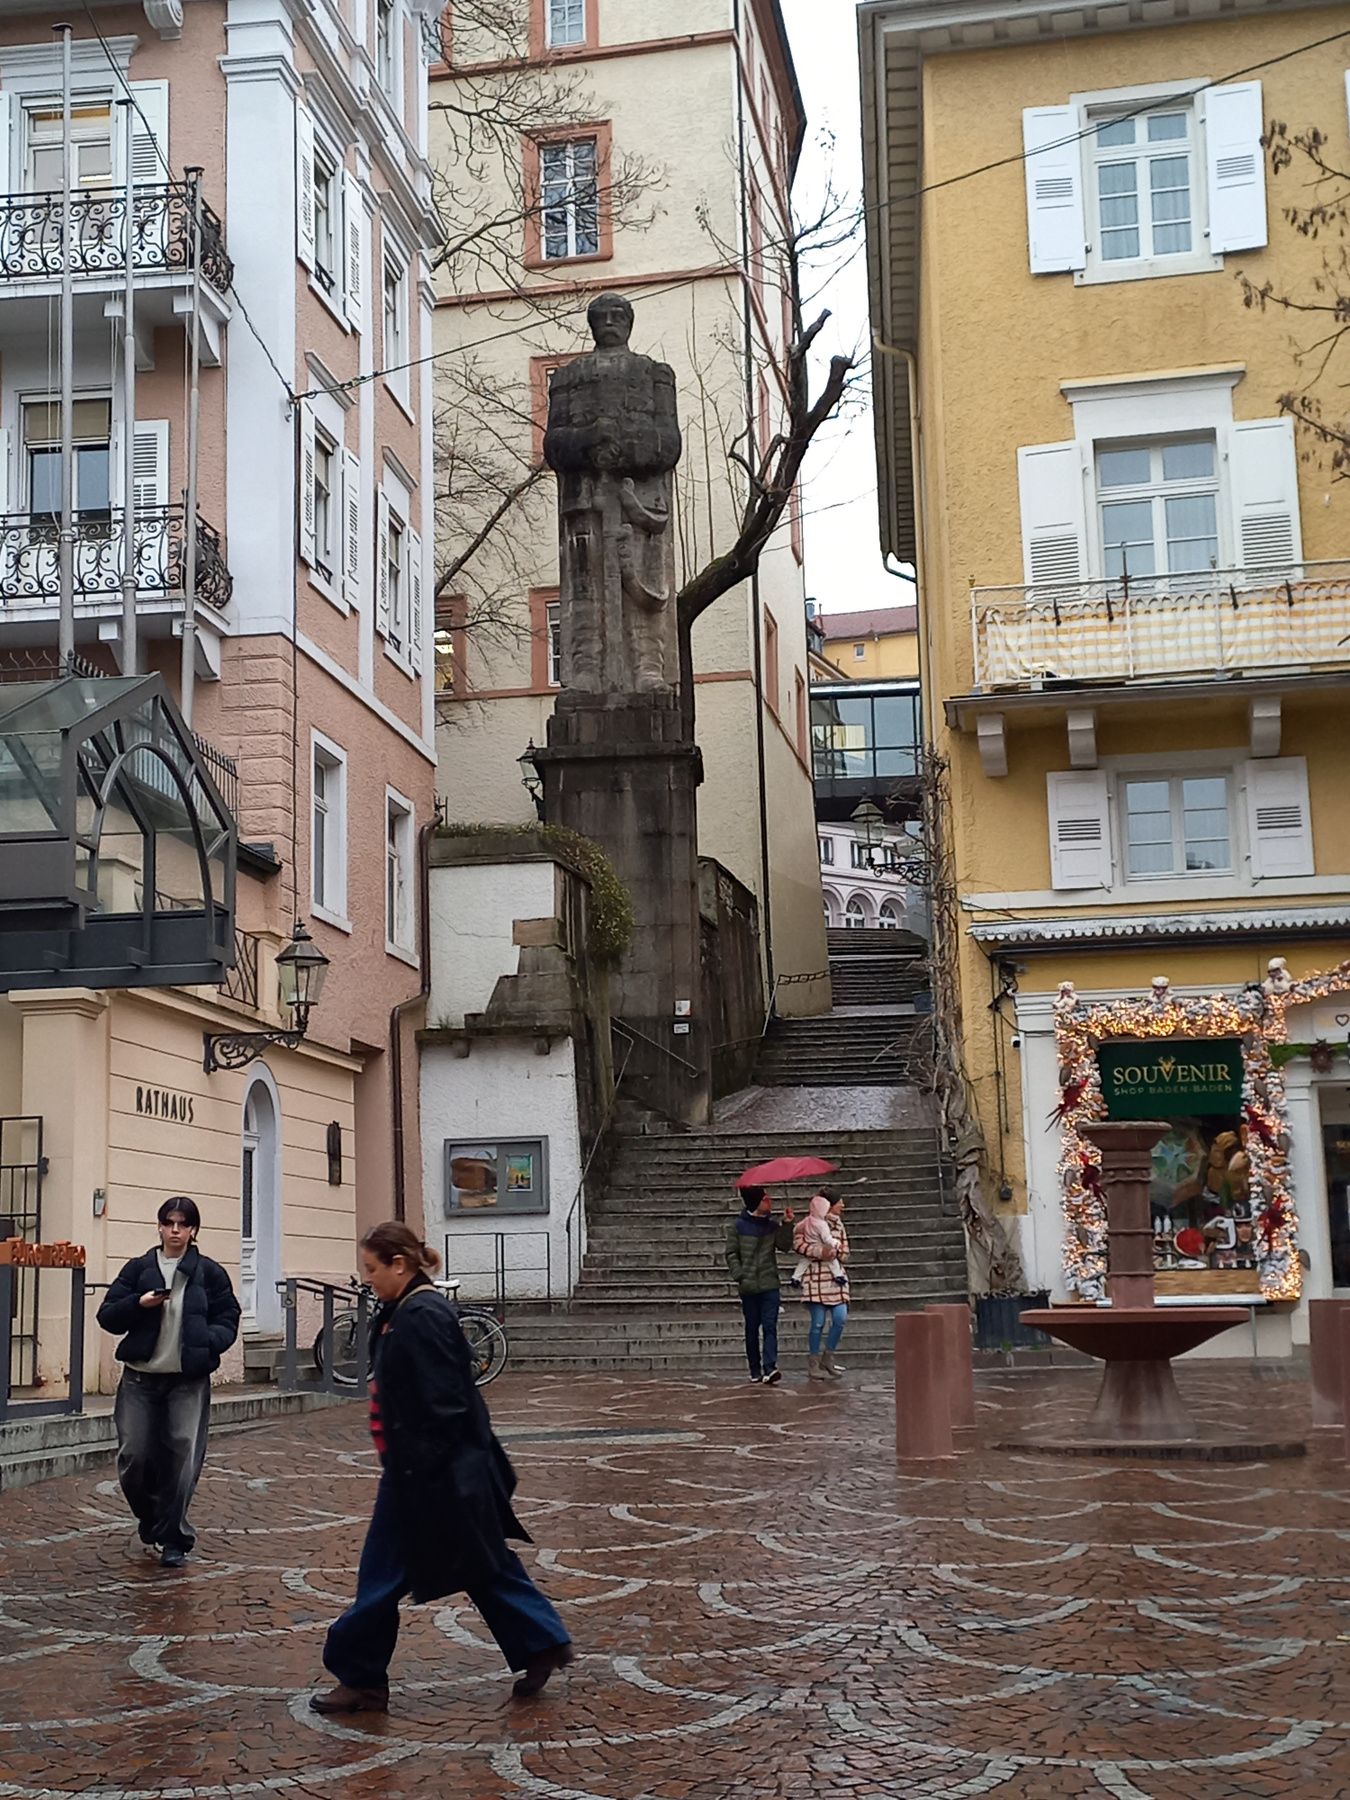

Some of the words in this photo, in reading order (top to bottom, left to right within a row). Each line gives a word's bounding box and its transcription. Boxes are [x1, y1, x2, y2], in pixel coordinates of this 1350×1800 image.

[1113, 1063, 1231, 1085] SOUVENIR
[1114, 1087, 1145, 1096] SHOP
[1149, 1084, 1233, 1094] BADEN-BADEN
[136, 1086, 194, 1124] RATHAUS
